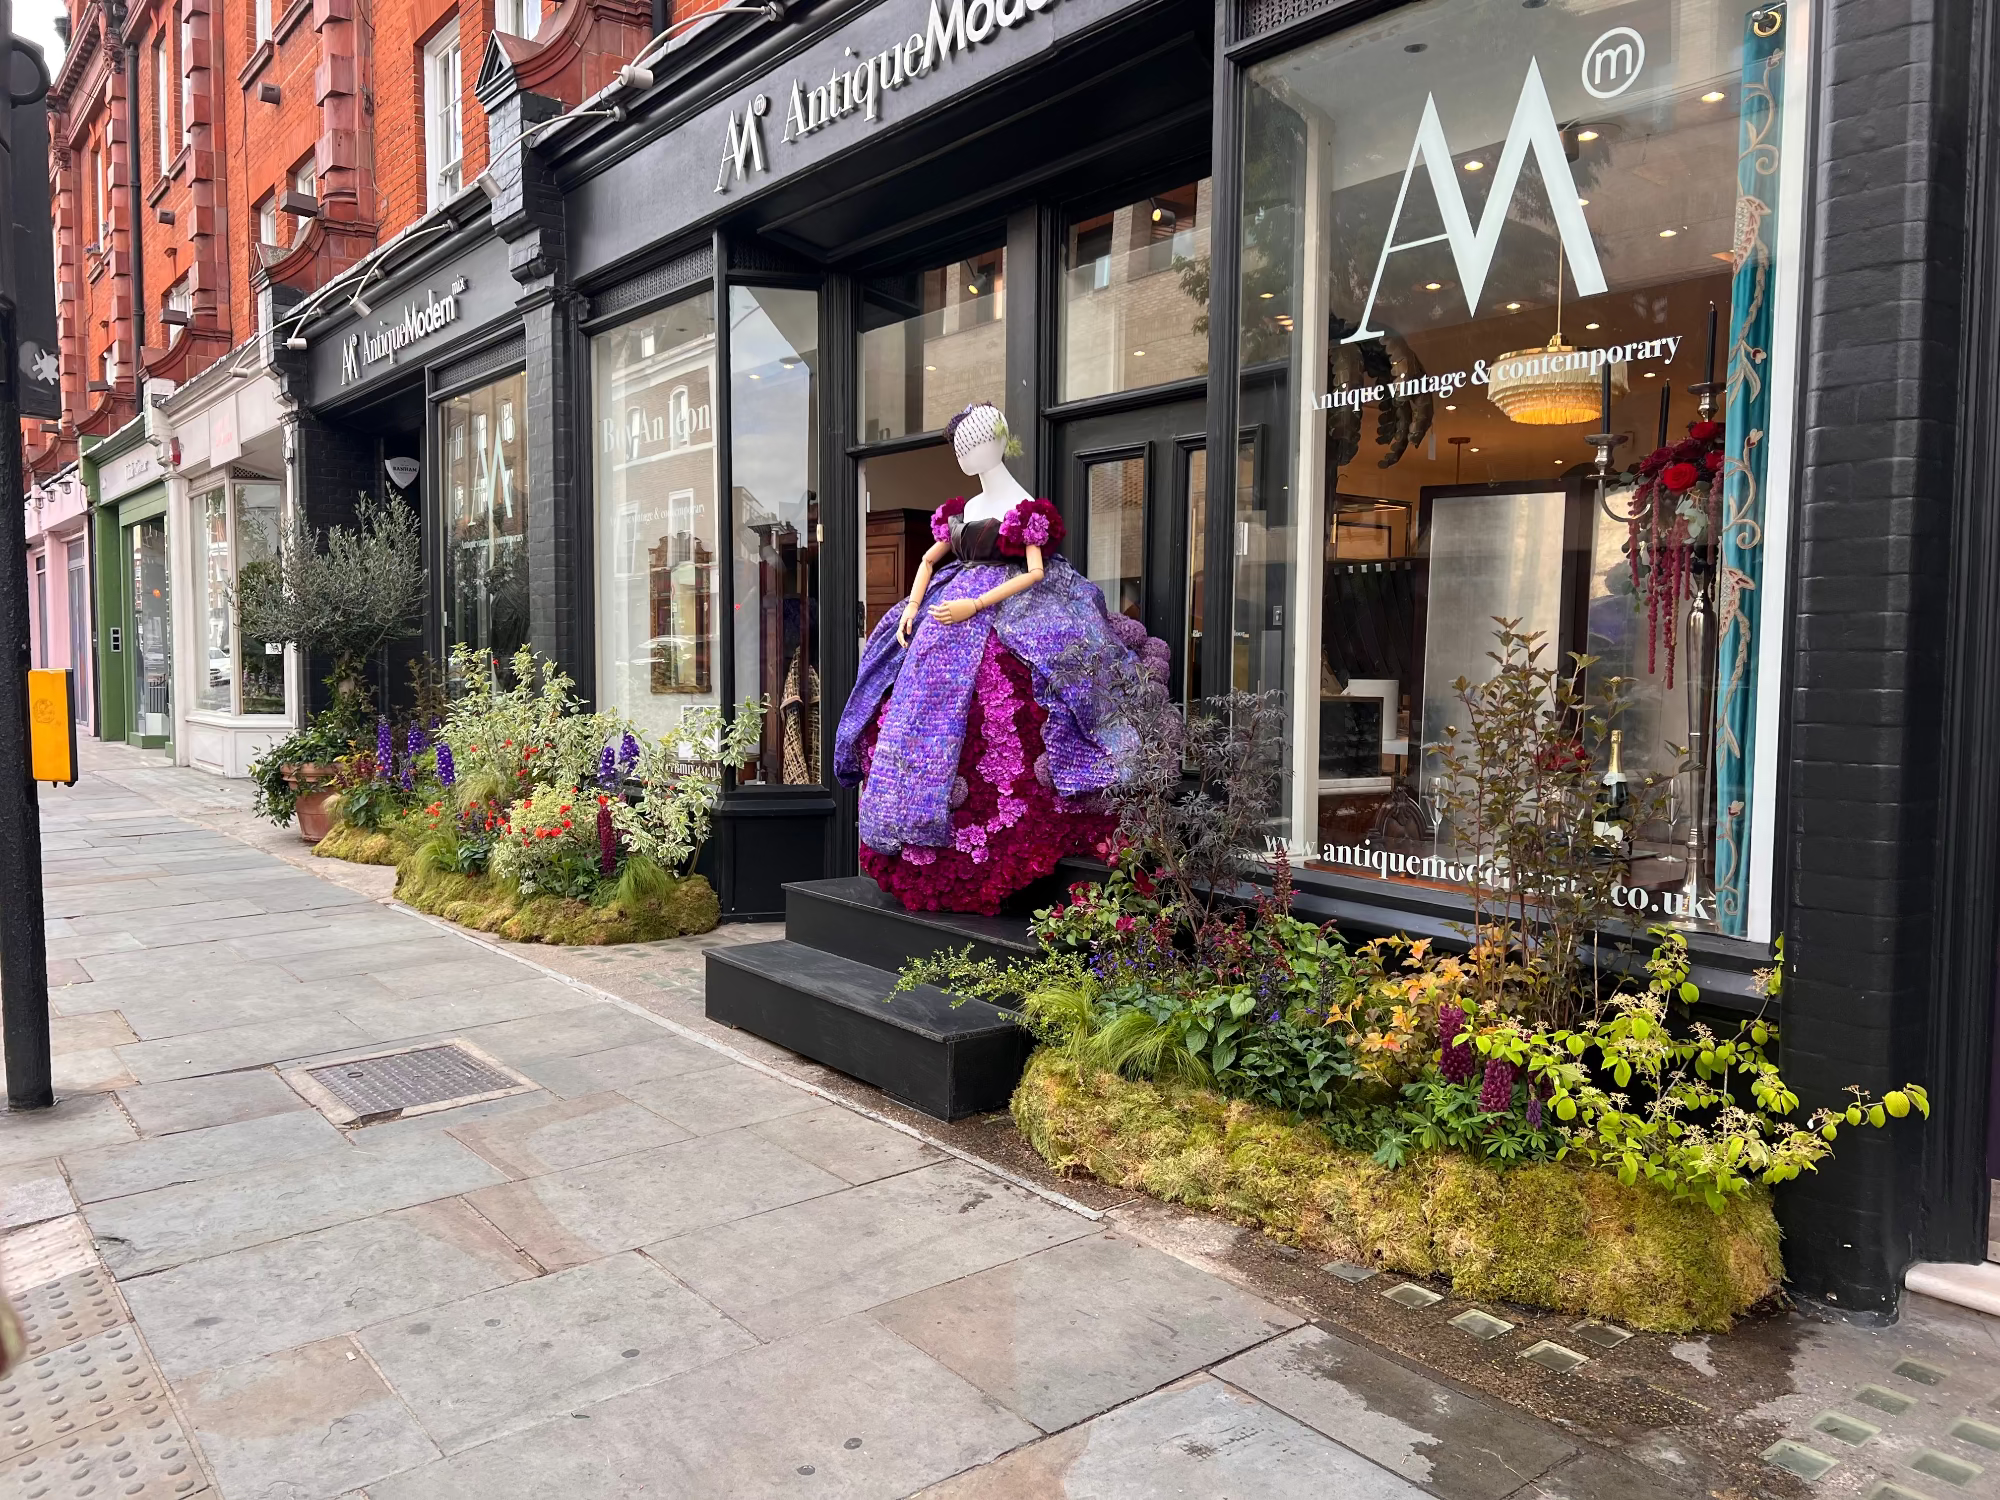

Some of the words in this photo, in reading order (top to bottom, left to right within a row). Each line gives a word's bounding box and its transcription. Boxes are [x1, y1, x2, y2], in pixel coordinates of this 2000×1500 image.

[781, 0, 1051, 142] AntiqueMo
[363, 288, 455, 366] AntiqueModern
[1310, 378, 1385, 412] Antique
[1391, 371, 1467, 399] vintage
[1471, 359, 1491, 385] &
[1496, 335, 1683, 382] contemporary
[640, 408, 664, 445] An
